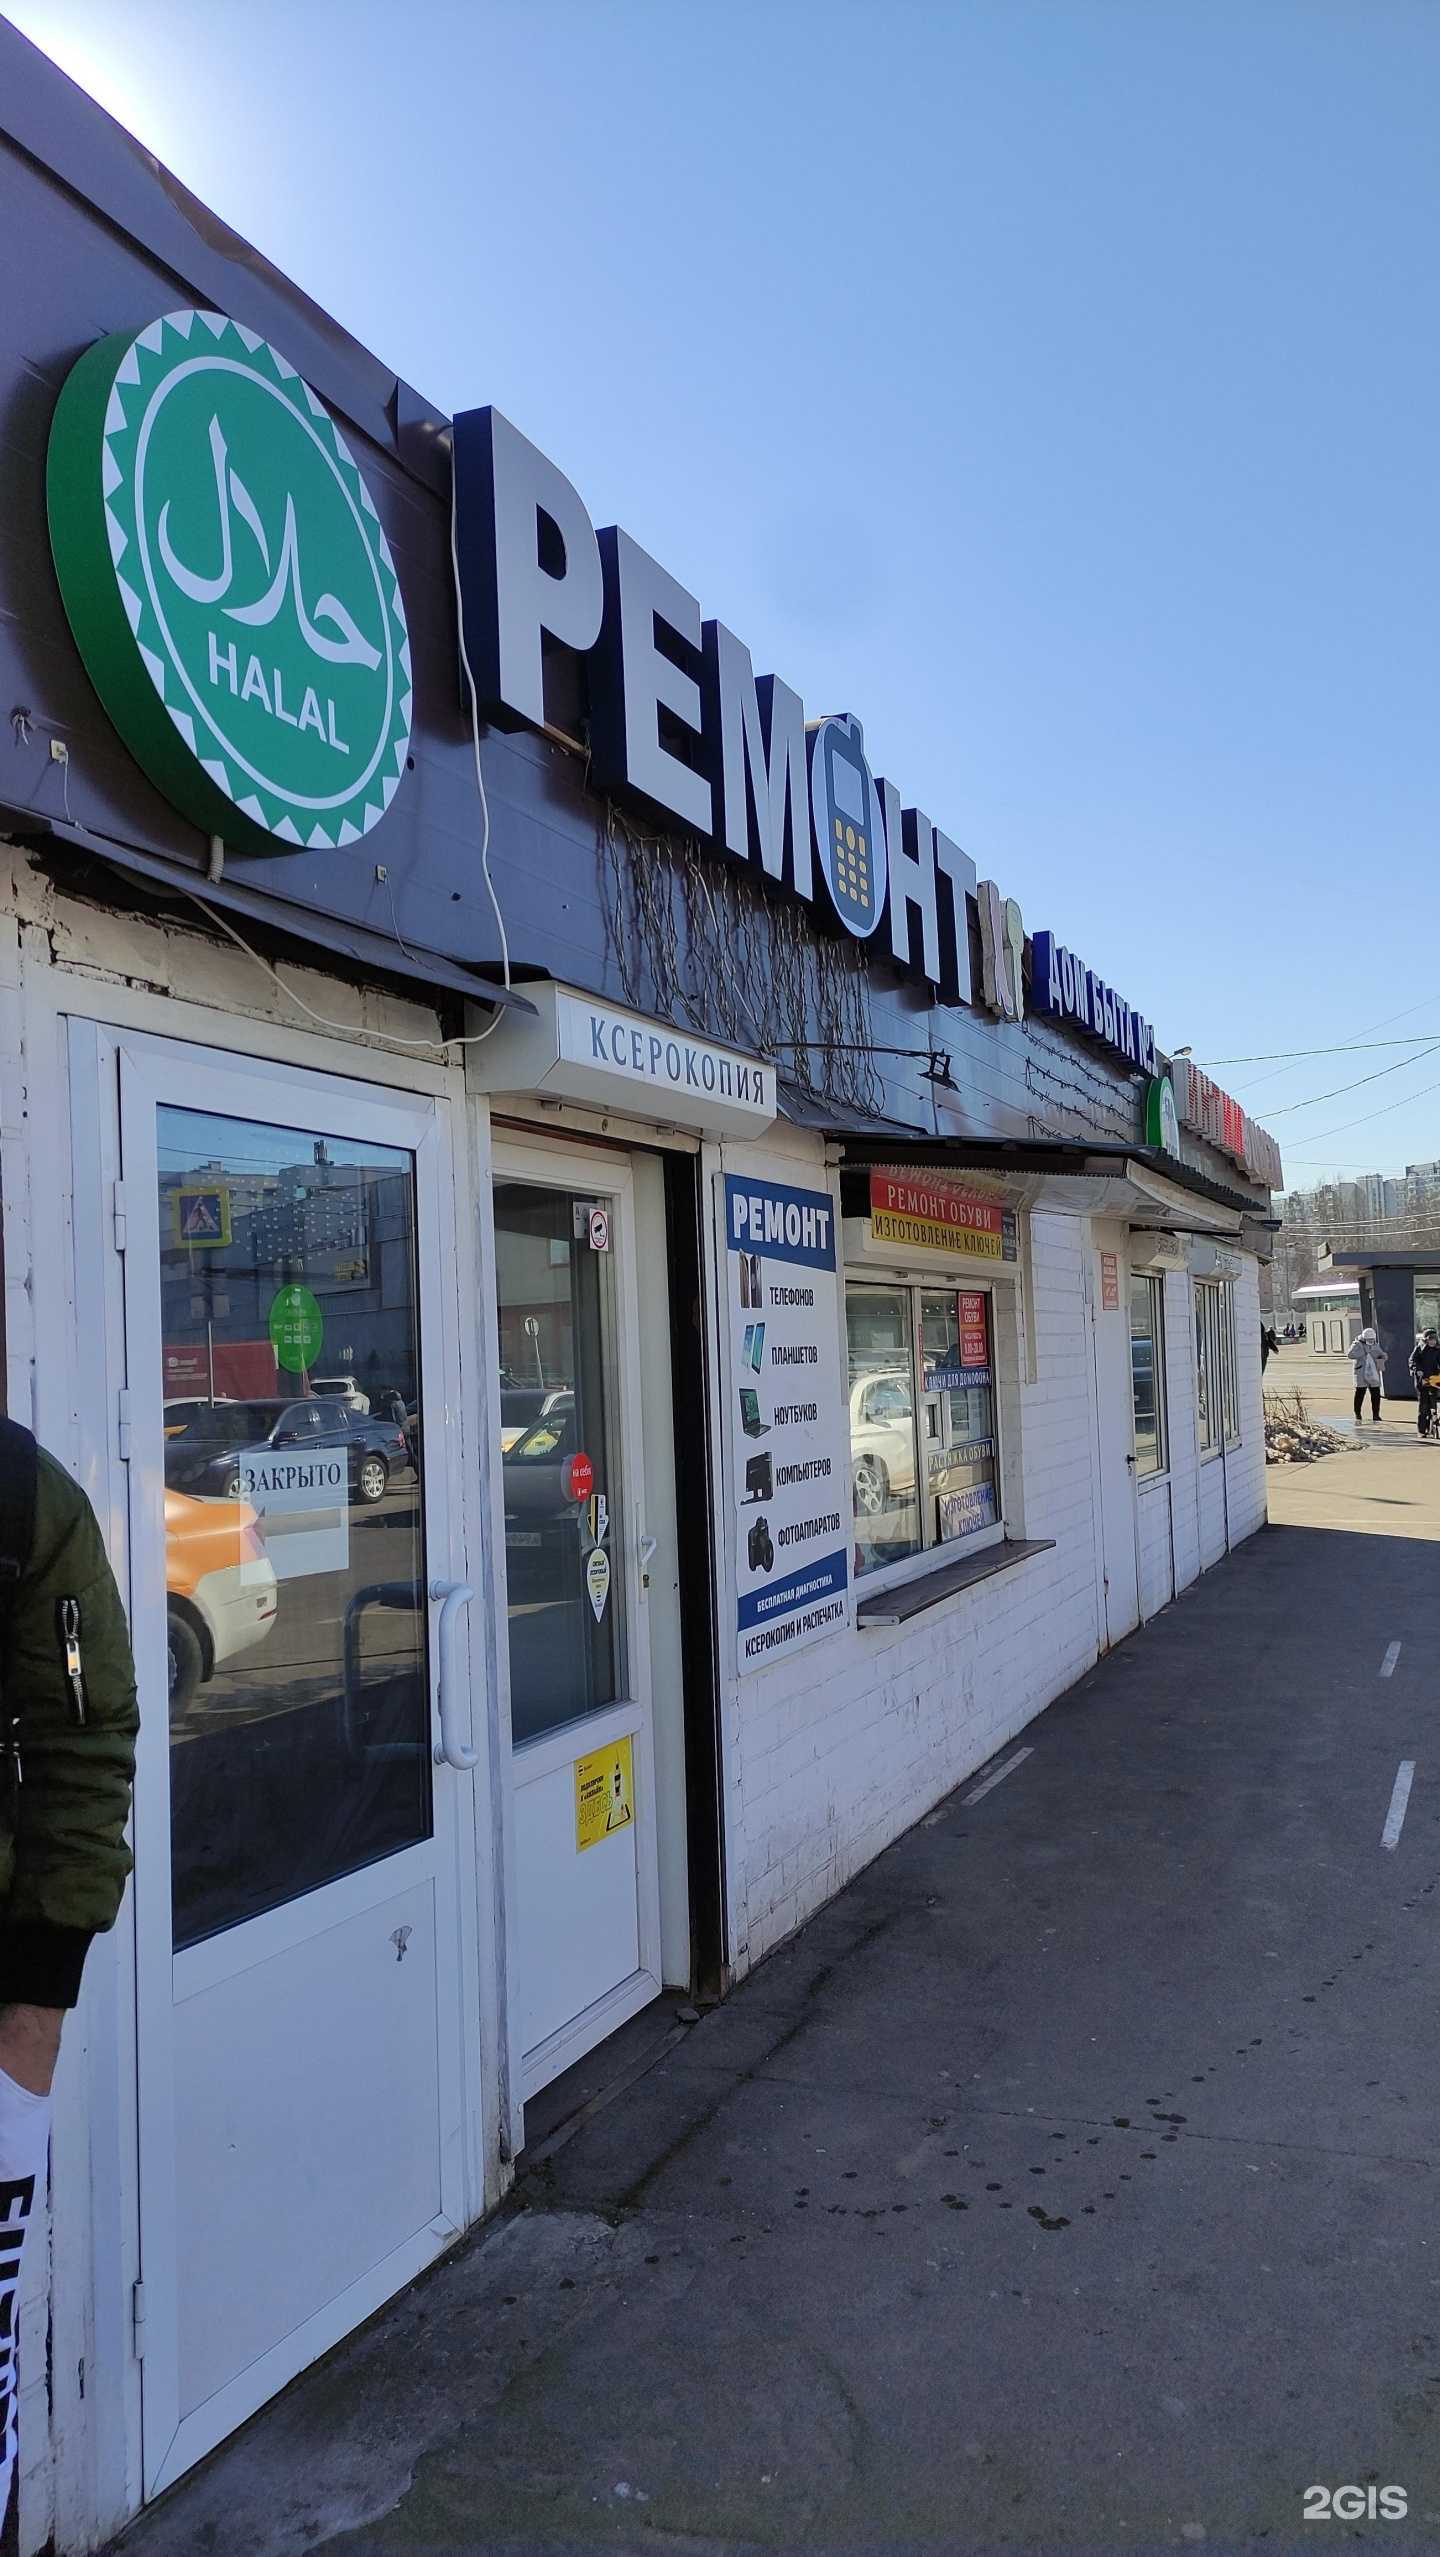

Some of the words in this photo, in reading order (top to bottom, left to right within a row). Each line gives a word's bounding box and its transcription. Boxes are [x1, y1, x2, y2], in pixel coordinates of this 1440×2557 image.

[158, 413, 382, 671] حلال
[208, 631, 349, 754] HALAL
[1049, 930, 1089, 1025] ДОМ
[1092, 971, 1136, 1061] БЫТА
[590, 1016, 764, 1105] КСЕРОКОПИЯ
[732, 1193, 829, 1249] РЕМОНТ
[887, 1184, 946, 1219] РЕМОНТ
[950, 1201, 992, 1229] ОБУВИ
[875, 1215, 961, 1249] ИЗГОТОВЛЕНИЕ
[964, 1233, 1001, 1257] КЛЮЧЕЙ
[769, 1287, 814, 1307] ТЕЛЕФОНОВ
[771, 1346, 818, 1365] ПЛАНШЕТОВ
[948, 1373, 959, 1387] ДЛЯ
[774, 1403, 817, 1426] НОУТБУКОВ
[969, 1442, 991, 1460] ОБУВИ
[245, 1463, 341, 1492] ЗАКРЫТО
[776, 1458, 831, 1487] КОМПЬЮТЕРОВ
[778, 1513, 840, 1547] ФОТОАППАРАТОВ
[757, 1588, 795, 1613] БЕСПЛАТНАЯ
[795, 1574, 833, 1600] ДИАГНОСТИКА
[745, 1621, 795, 1658] КСЕРОКОПИЯ
[796, 1618, 802, 1635] И
[802, 1600, 843, 1633] РАСПЕЧАТКА
